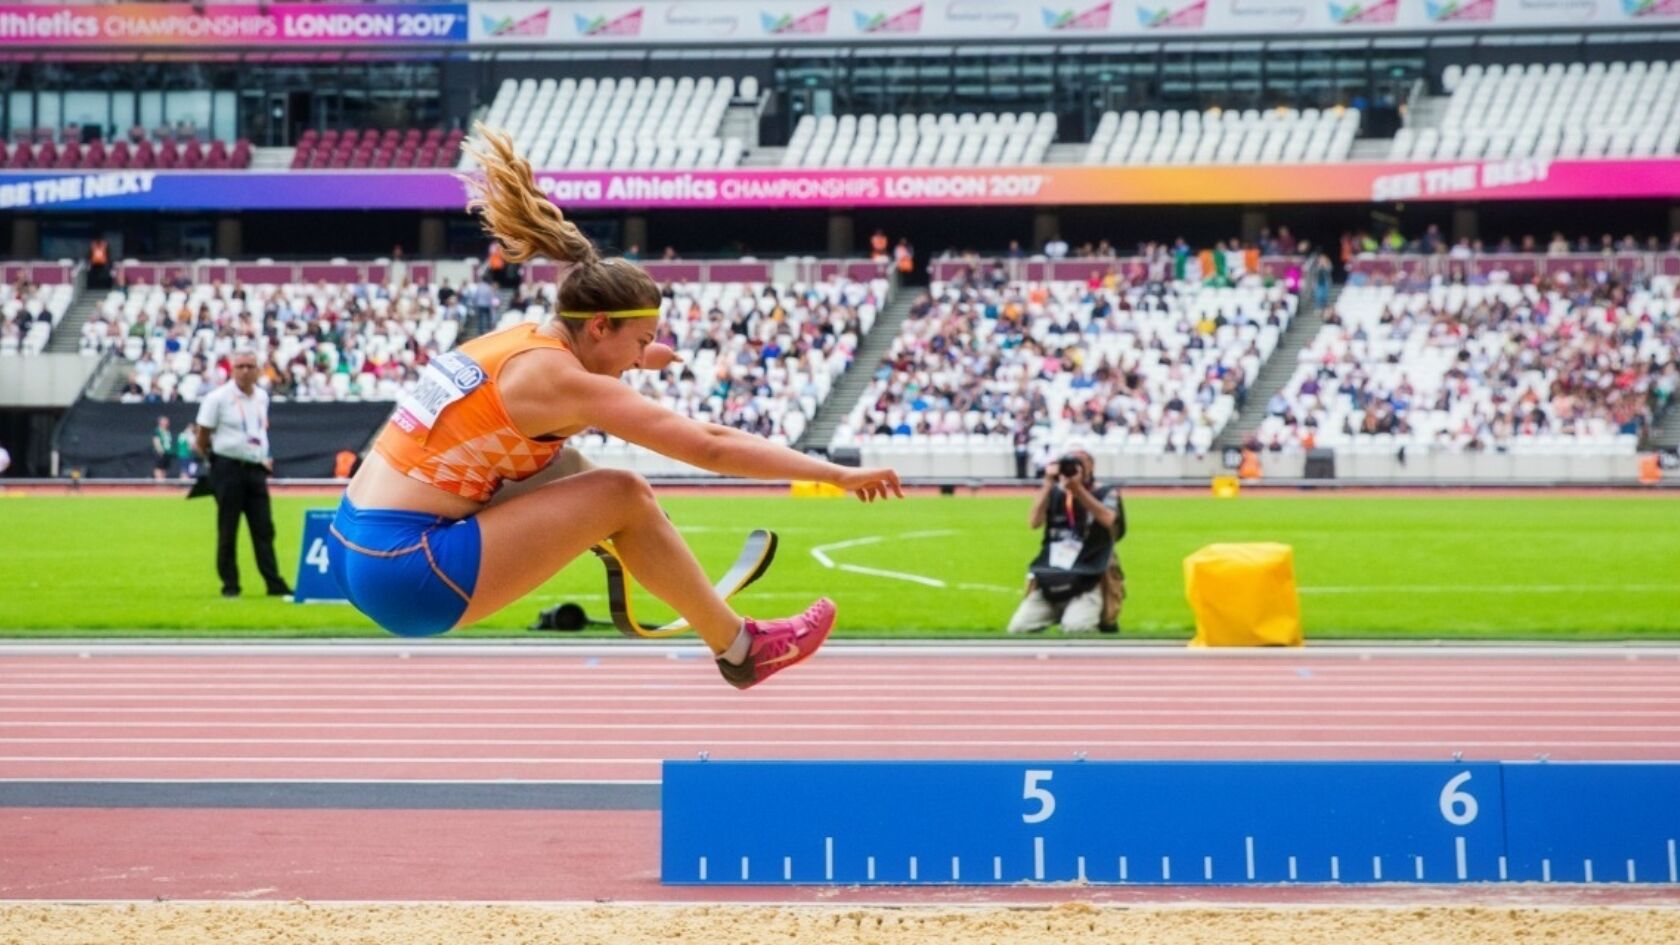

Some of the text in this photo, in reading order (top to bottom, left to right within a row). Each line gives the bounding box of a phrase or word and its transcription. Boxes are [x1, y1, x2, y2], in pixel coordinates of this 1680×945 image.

[104, 14, 277, 37] CHAMPIONSHIPS
[284, 13, 394, 37] LONDON
[398, 13, 456, 37] 2017
[0, 172, 155, 207] BE THE NEXT
[538, 174, 1043, 200] Para Athletics CHAMPIONSHIPS LONDON 2017
[1372, 159, 1549, 201] SEE THE BEST
[305, 537, 330, 573] 4
[1021, 770, 1056, 824] 5
[1439, 770, 1478, 826] 6
